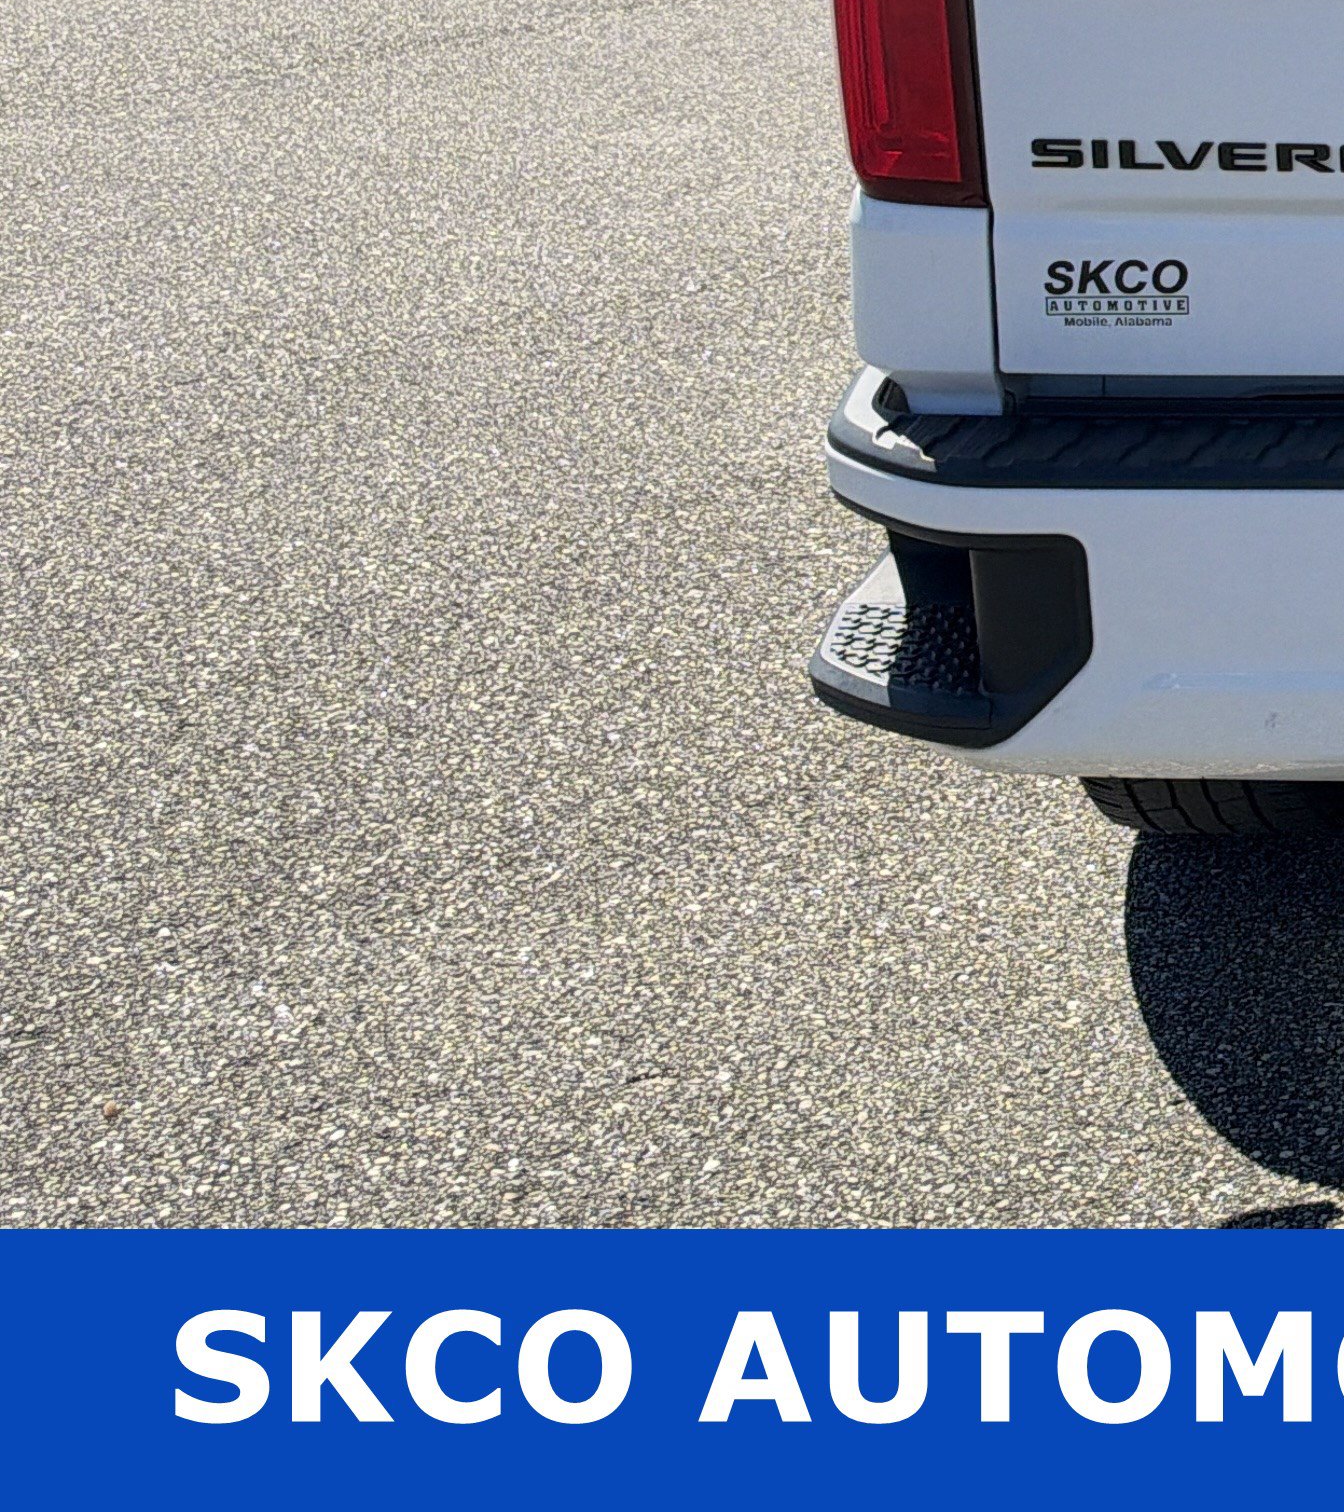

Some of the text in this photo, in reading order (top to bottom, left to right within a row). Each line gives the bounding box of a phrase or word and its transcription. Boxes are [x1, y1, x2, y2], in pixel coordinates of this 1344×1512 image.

[1044, 259, 1189, 295] SKCO
[1050, 299, 1186, 312] AUTOMOTIVE
[1064, 317, 1173, 328] Mobile, Alabama
